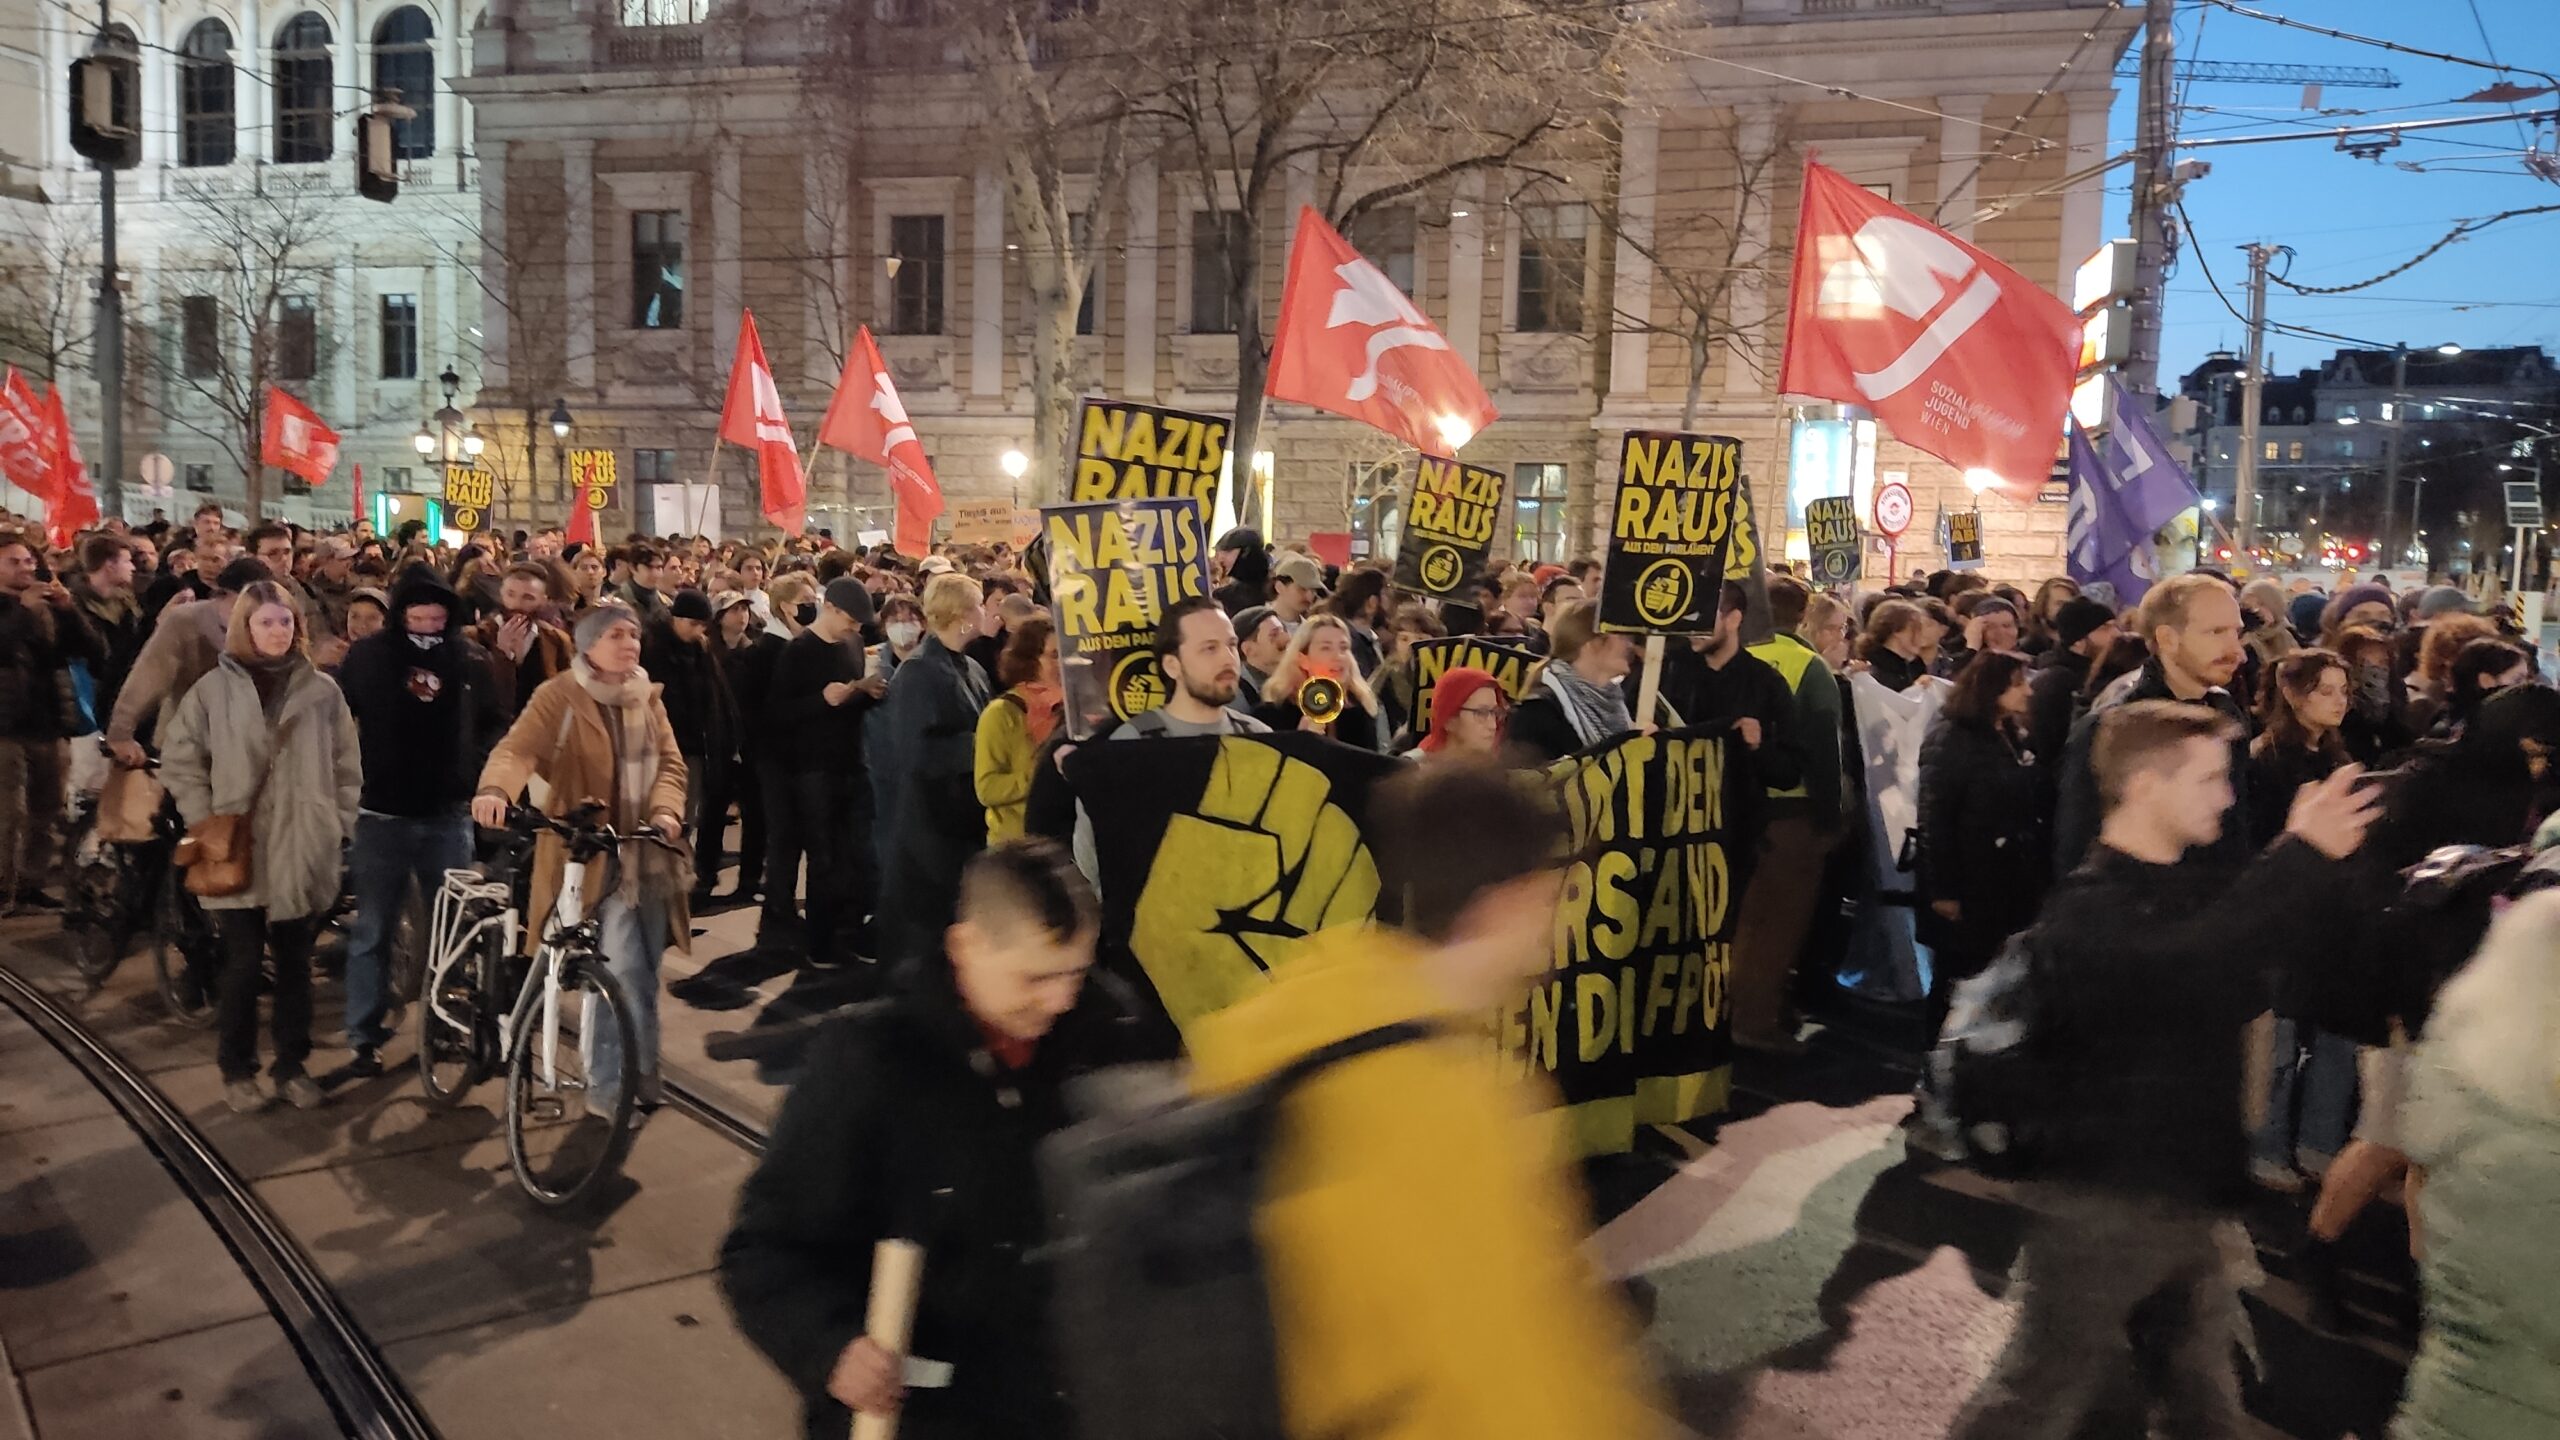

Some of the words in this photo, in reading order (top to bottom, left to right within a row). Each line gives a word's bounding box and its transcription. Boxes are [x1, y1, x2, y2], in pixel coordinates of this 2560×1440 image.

[1920, 410, 1951, 436] WIEN
[1925, 396, 1971, 430] JUGEND
[1080, 405, 1226, 474] NAZIS
[570, 450, 615, 467] NAZIS
[1624, 437, 1737, 491] NAZIS
[446, 468, 492, 490] NAZIS
[1416, 458, 1503, 508] NAZIS
[446, 484, 491, 506] RAUS
[1409, 490, 1495, 542] RAUS
[1615, 486, 1731, 543] RAUS
[1808, 499, 1854, 522] NAZIS
[1049, 506, 1198, 570] NAZIS
[1622, 540, 1641, 553] AUS
[1643, 541, 1664, 554] DEM
[1810, 519, 1856, 545] RAUS
[1078, 634, 1101, 653] AUS
[1102, 632, 1131, 650] DEM
[1662, 736, 1726, 838] DEN
